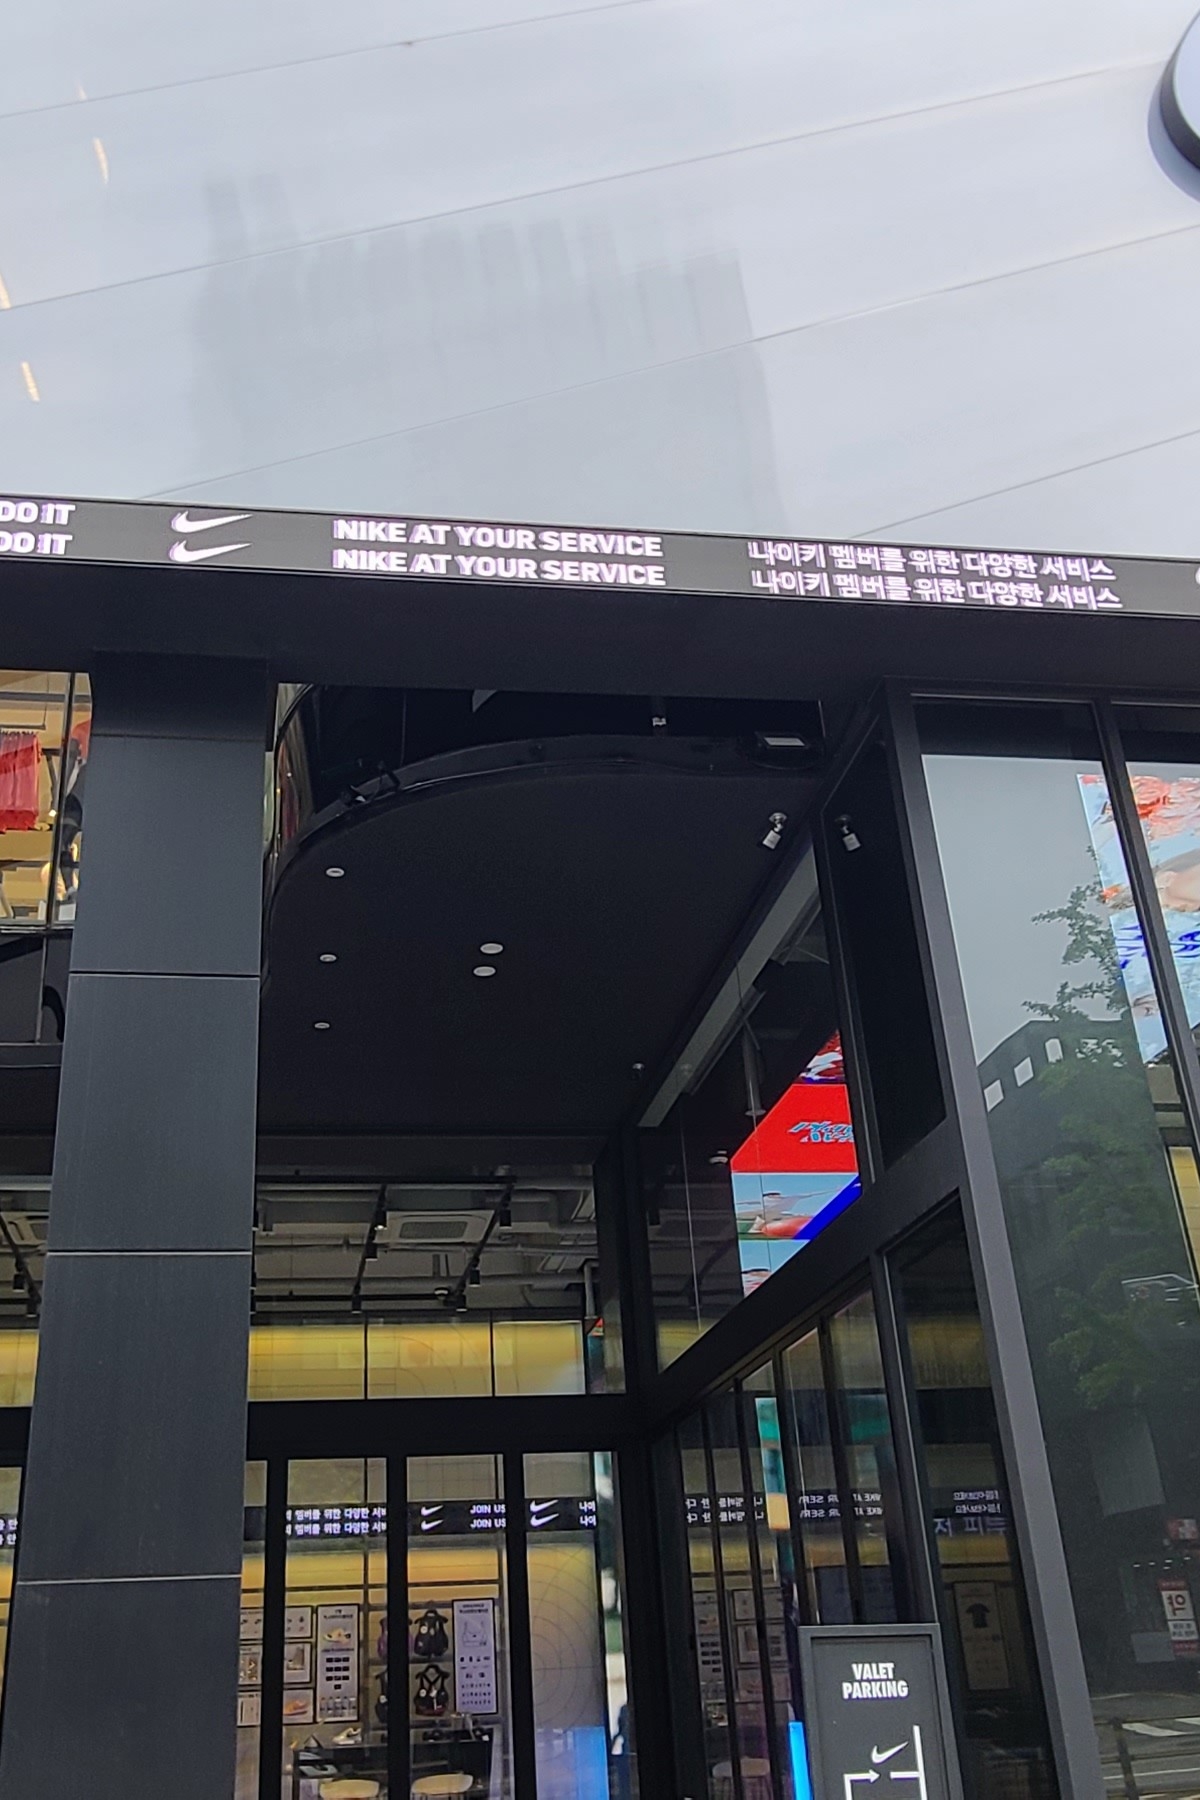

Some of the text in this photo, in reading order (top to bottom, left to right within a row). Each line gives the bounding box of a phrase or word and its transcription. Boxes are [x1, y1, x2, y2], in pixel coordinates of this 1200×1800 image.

[0, 501, 76, 525] DO IT
[37, 533, 73, 555] IT
[333, 519, 664, 557] NIKE AT YOUR SERVICE
[332, 549, 666, 586] NIKE AT YOUR SERVICE
[747, 541, 1116, 582] 나이키 멤버를 위한 다양한 서비스
[751, 570, 1123, 610] 나이키 멤버를 위한 다양한 서비스
[470, 1504, 506, 1514] JOIN US
[470, 1517, 506, 1528] JOIN US
[852, 1662, 895, 1680] VALET
[842, 1680, 909, 1699] PARKING
